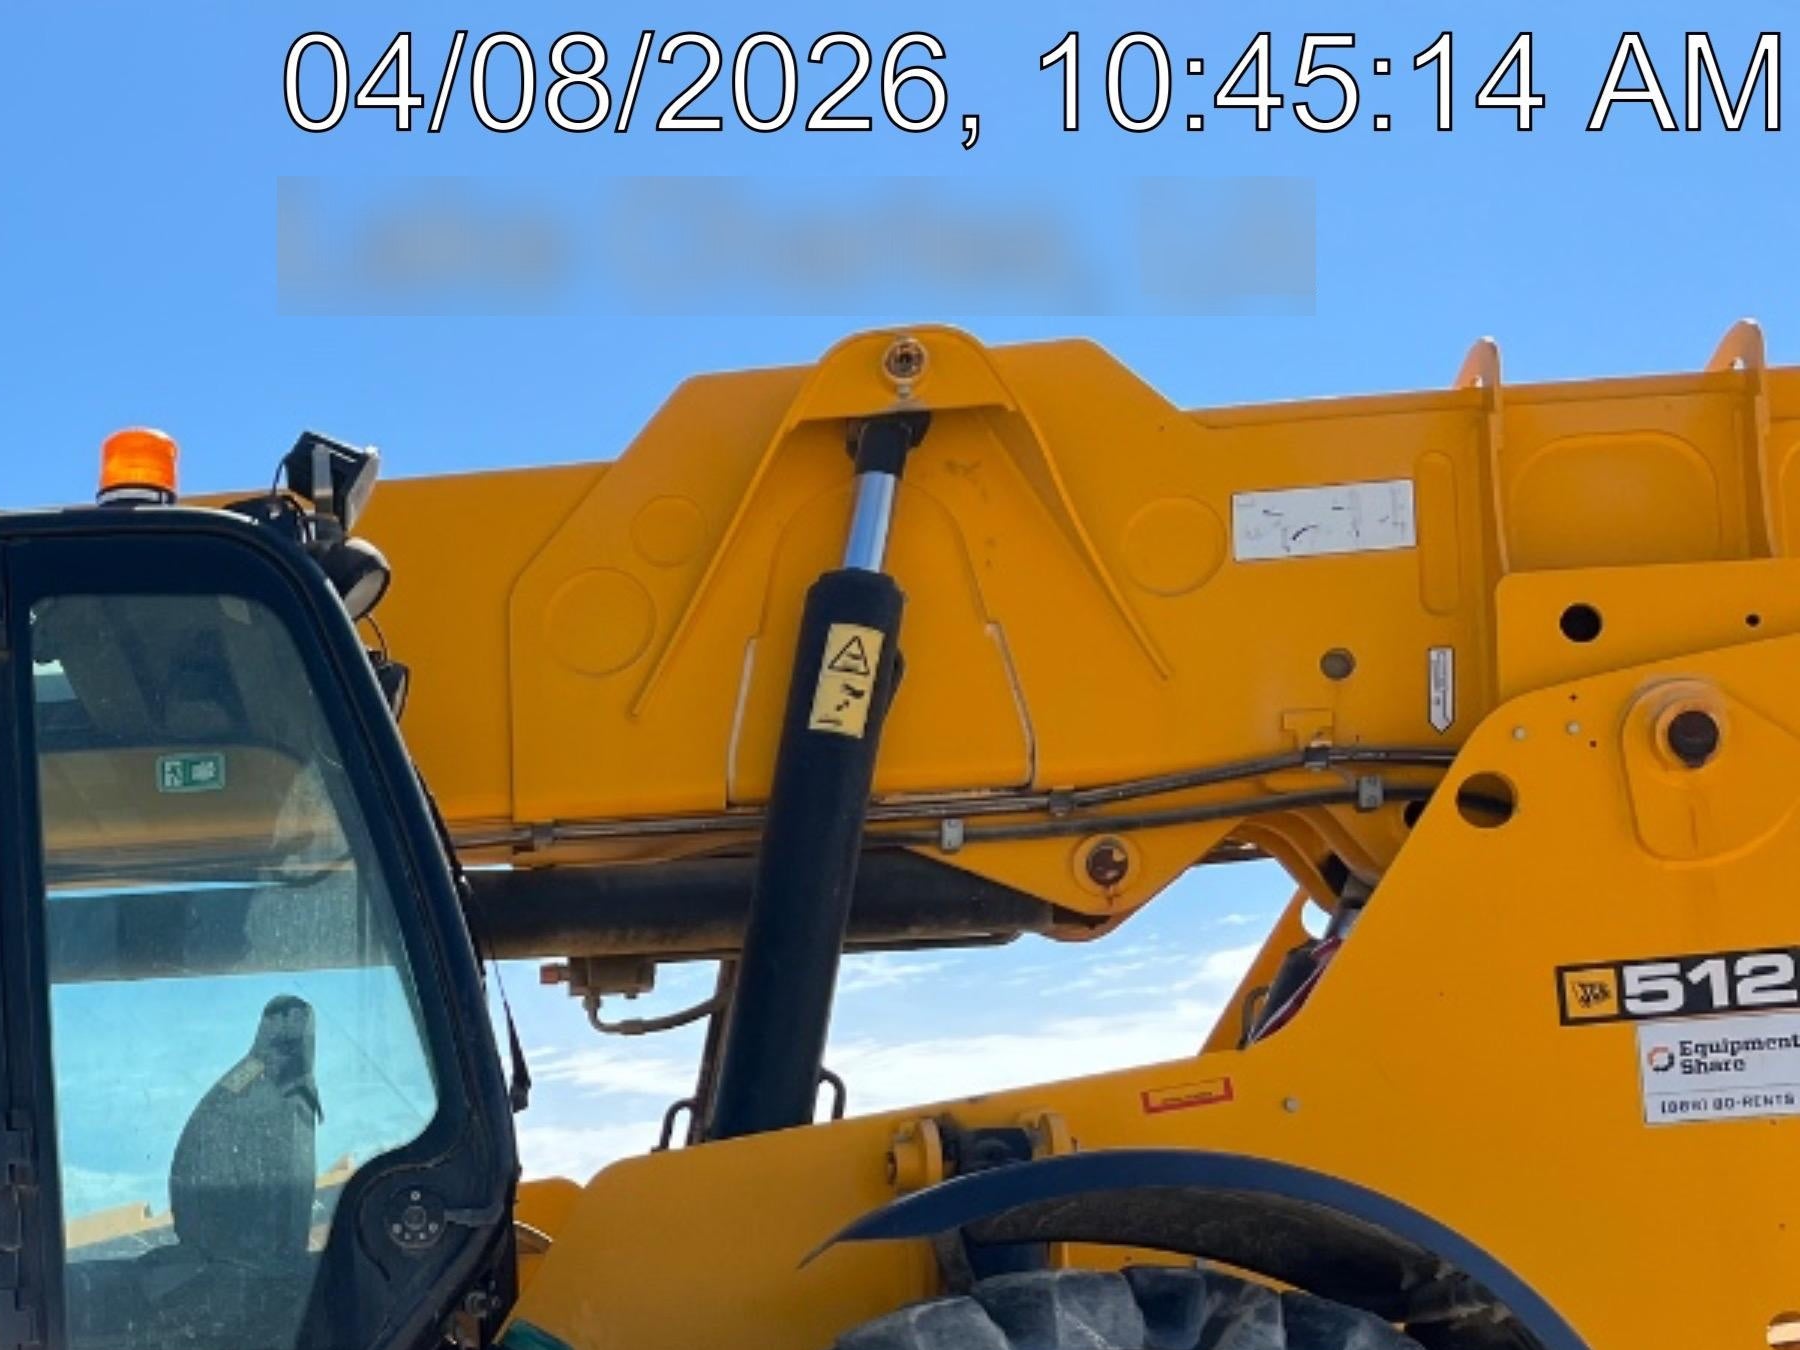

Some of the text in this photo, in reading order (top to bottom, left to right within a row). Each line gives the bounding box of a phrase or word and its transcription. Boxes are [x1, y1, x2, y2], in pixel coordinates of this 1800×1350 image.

[1623, 953, 1798, 1015] 512
[1679, 1034, 1800, 1060] Equipment
[1679, 1057, 1746, 1075] Share
